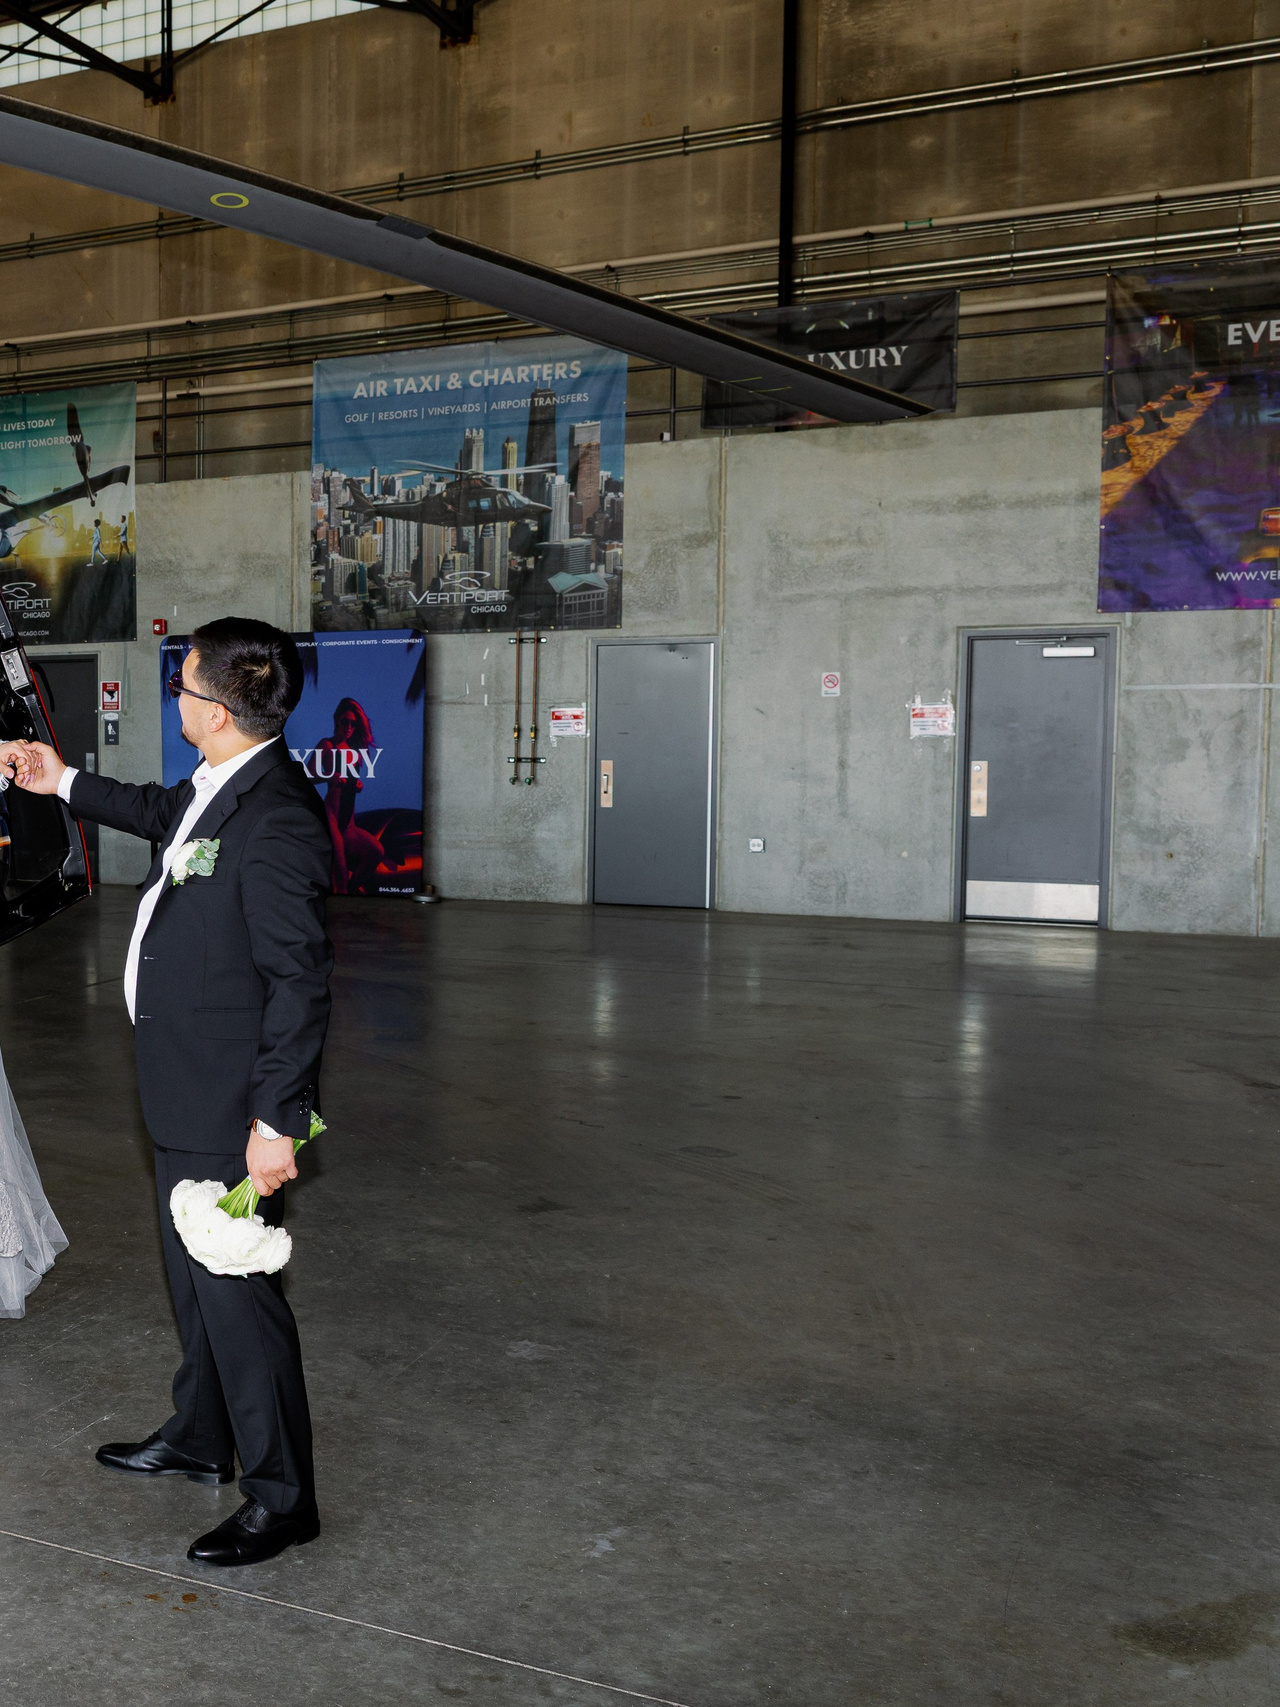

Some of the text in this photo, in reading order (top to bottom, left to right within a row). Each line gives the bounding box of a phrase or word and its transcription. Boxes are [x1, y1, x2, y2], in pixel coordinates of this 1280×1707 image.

[353, 361, 582, 399] AIR TAXI & CHARTERS
[344, 413, 369, 424] GOLF
[378, 409, 418, 420] RESORTS
[428, 402, 481, 416] VINEYARDS
[490, 398, 532, 411] AIRPORT
[533, 393, 589, 407] TRANSFERS
[3, 422, 26, 432] LIVES
[27, 418, 56, 429] TODAY
[27, 434, 82, 448] TOMORROW
[408, 589, 510, 605] VERTIPORT
[22, 611, 51, 619] CHICAGO
[470, 604, 507, 614] CHICAGO
